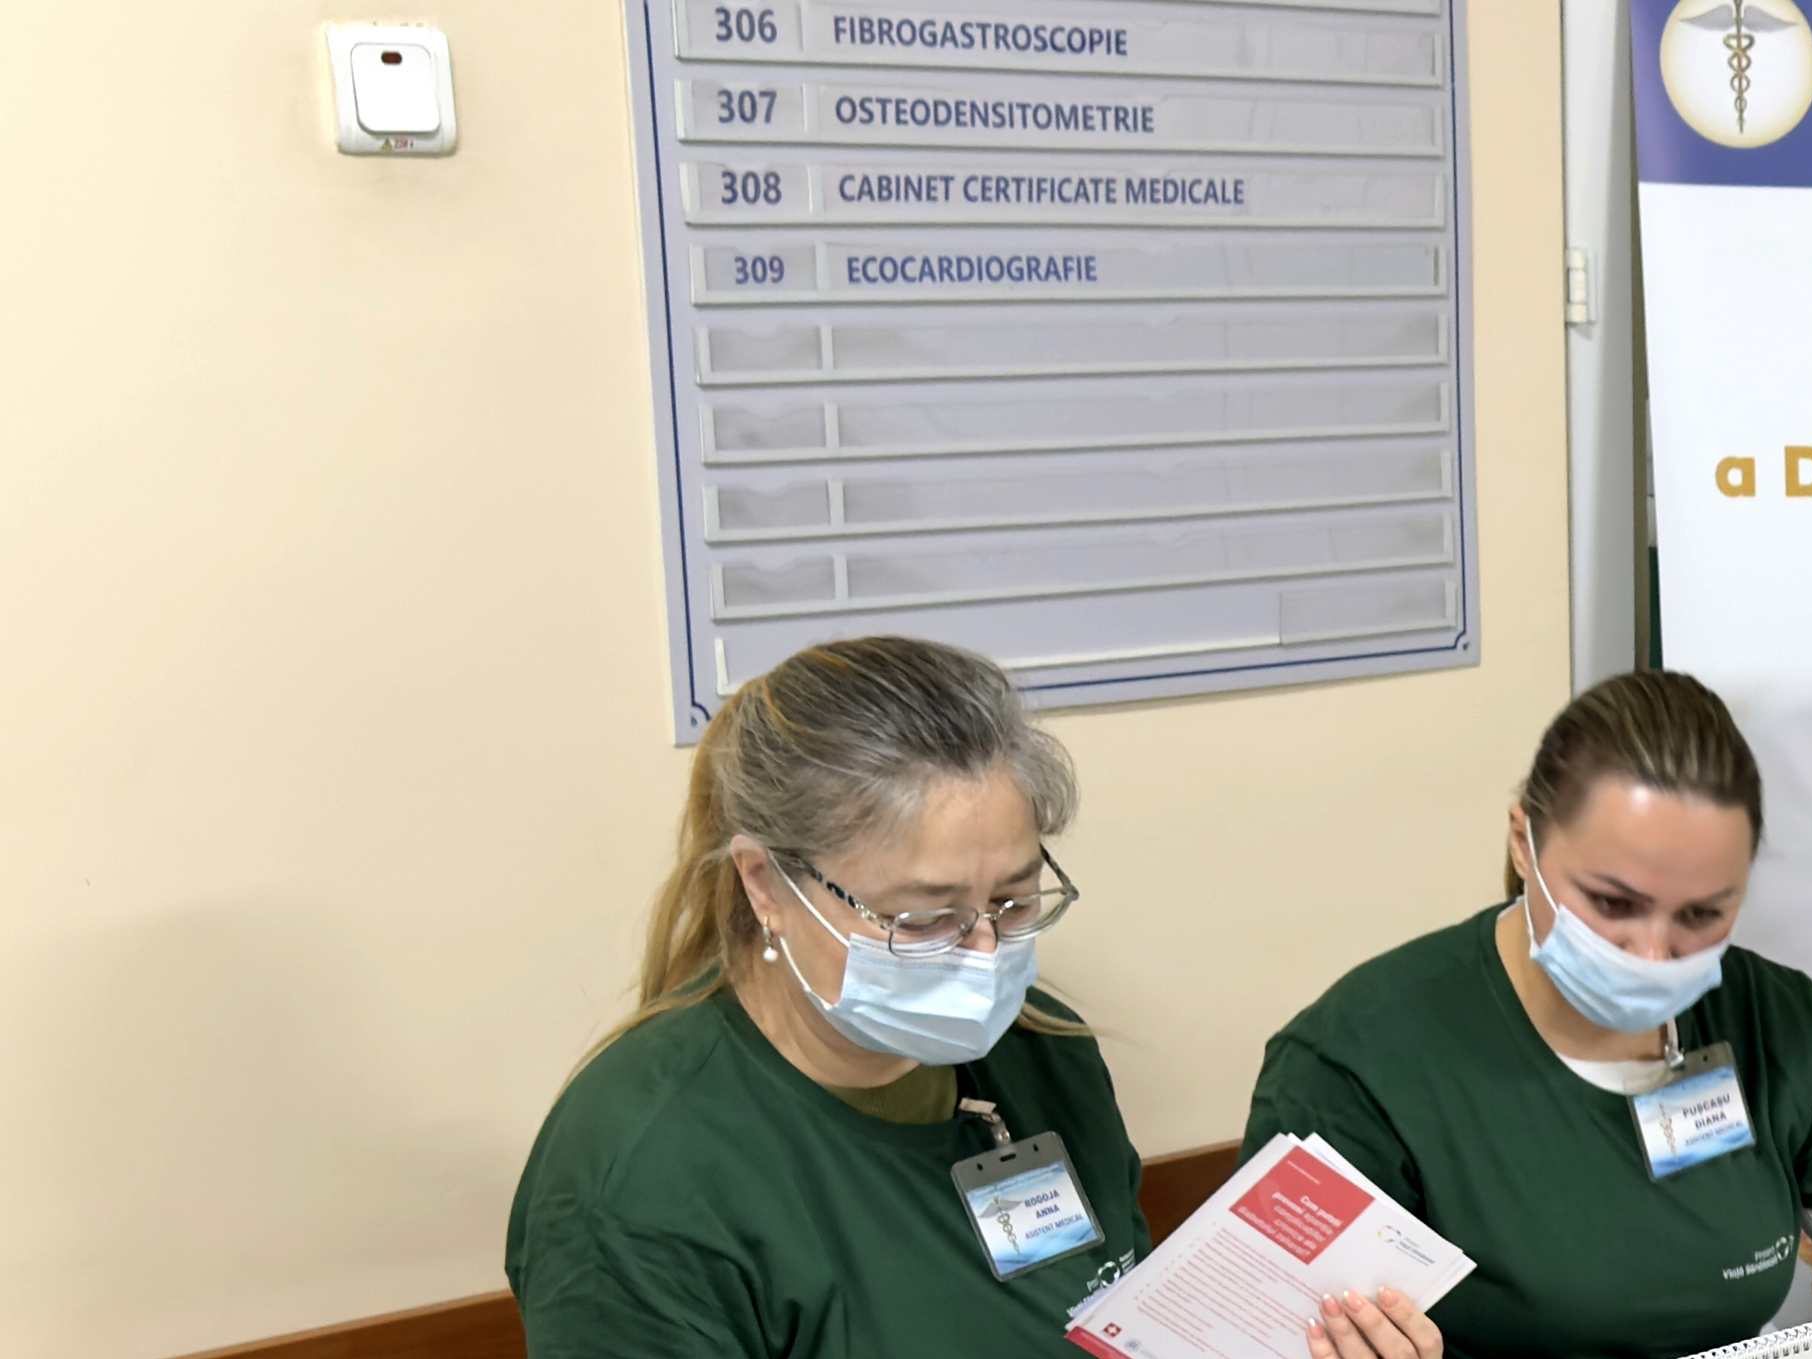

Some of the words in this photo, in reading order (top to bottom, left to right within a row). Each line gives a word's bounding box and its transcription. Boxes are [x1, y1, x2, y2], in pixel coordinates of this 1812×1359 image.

[715, 6, 777, 43] 306
[833, 16, 1128, 56] FIBROGASTROSCOPIE
[717, 89, 777, 124] 307
[835, 96, 1155, 135] OSTEODENSITOMETRIE
[721, 170, 782, 205] 308
[838, 174, 955, 203] CABINET
[962, 175, 1118, 204] CERTIFICATE
[1125, 178, 1245, 205] MEDICALE
[733, 255, 785, 285] 309
[847, 255, 1098, 284] ECOCARDIOGRAFIE
[1715, 457, 1756, 497] a
[1695, 1112, 1727, 1130] DIANA
[1035, 1204, 1060, 1219] ANNA
[1055, 1213, 1084, 1229] MEDICAL
